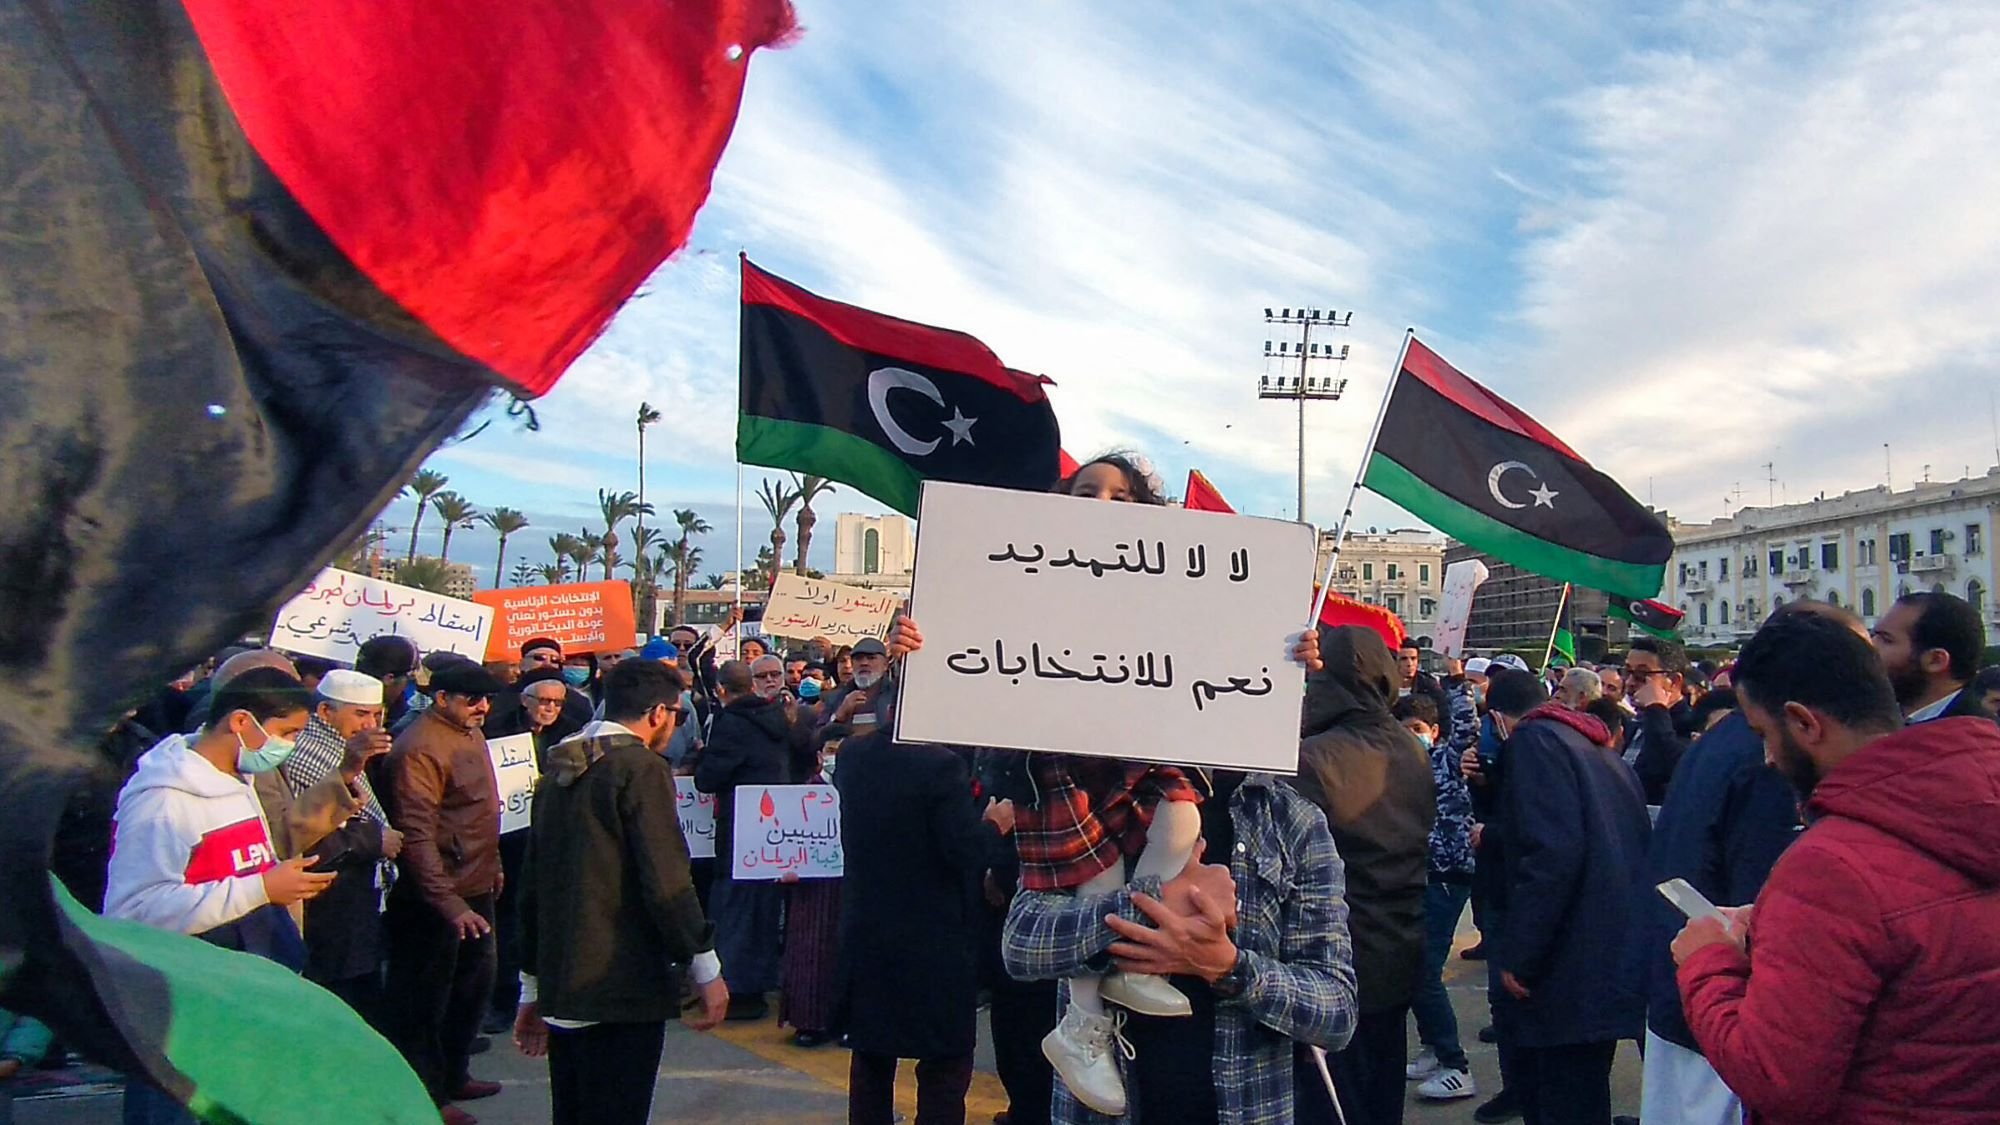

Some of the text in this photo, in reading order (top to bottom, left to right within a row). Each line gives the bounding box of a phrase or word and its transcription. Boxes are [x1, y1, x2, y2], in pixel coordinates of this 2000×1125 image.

[988, 539, 1249, 582] لا لا للتمديد
[343, 587, 415, 616] برلمان
[504, 595, 548, 609] الرئاسية
[579, 606, 604, 617] بدون
[418, 603, 483, 641] اسقاط
[507, 608, 535, 624] تعني
[508, 619, 604, 637] عودة الديكتاتورية
[947, 640, 1273, 710] نعم للانتخابات
[801, 791, 834, 822] دم
[743, 846, 808, 870] البرلمان
